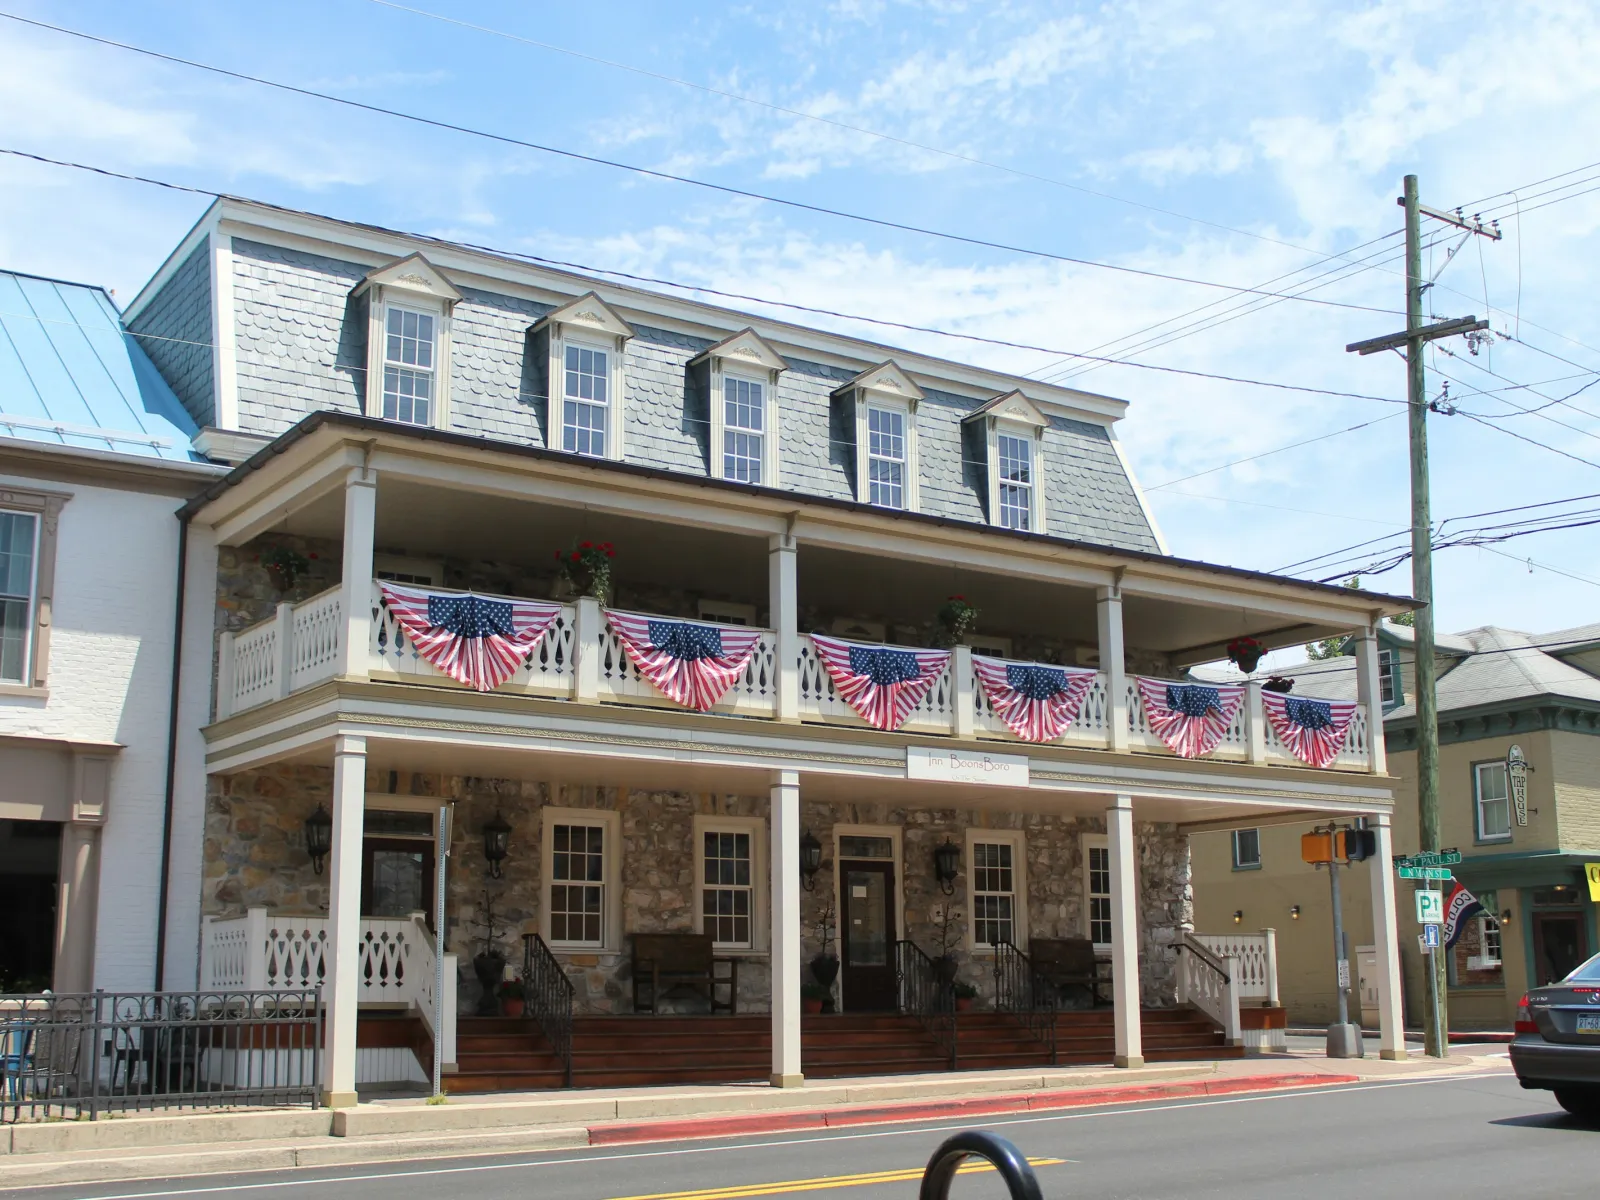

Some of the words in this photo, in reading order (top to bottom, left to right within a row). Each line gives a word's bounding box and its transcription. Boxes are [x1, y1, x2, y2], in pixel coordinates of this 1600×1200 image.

[928, 752, 943, 766] Inn
[950, 753, 1010, 771] BoonsBoro
[1512, 775, 1526, 788] TAP
[1517, 788, 1526, 825] HOUSE
[1421, 855, 1444, 865] PAUL
[1446, 853, 1457, 862] ST
[1407, 868, 1414, 877] N
[1415, 869, 1433, 877] MAIN
[1435, 870, 1443, 878] ST
[1590, 866, 1600, 884] C
[1420, 895, 1431, 917] P
